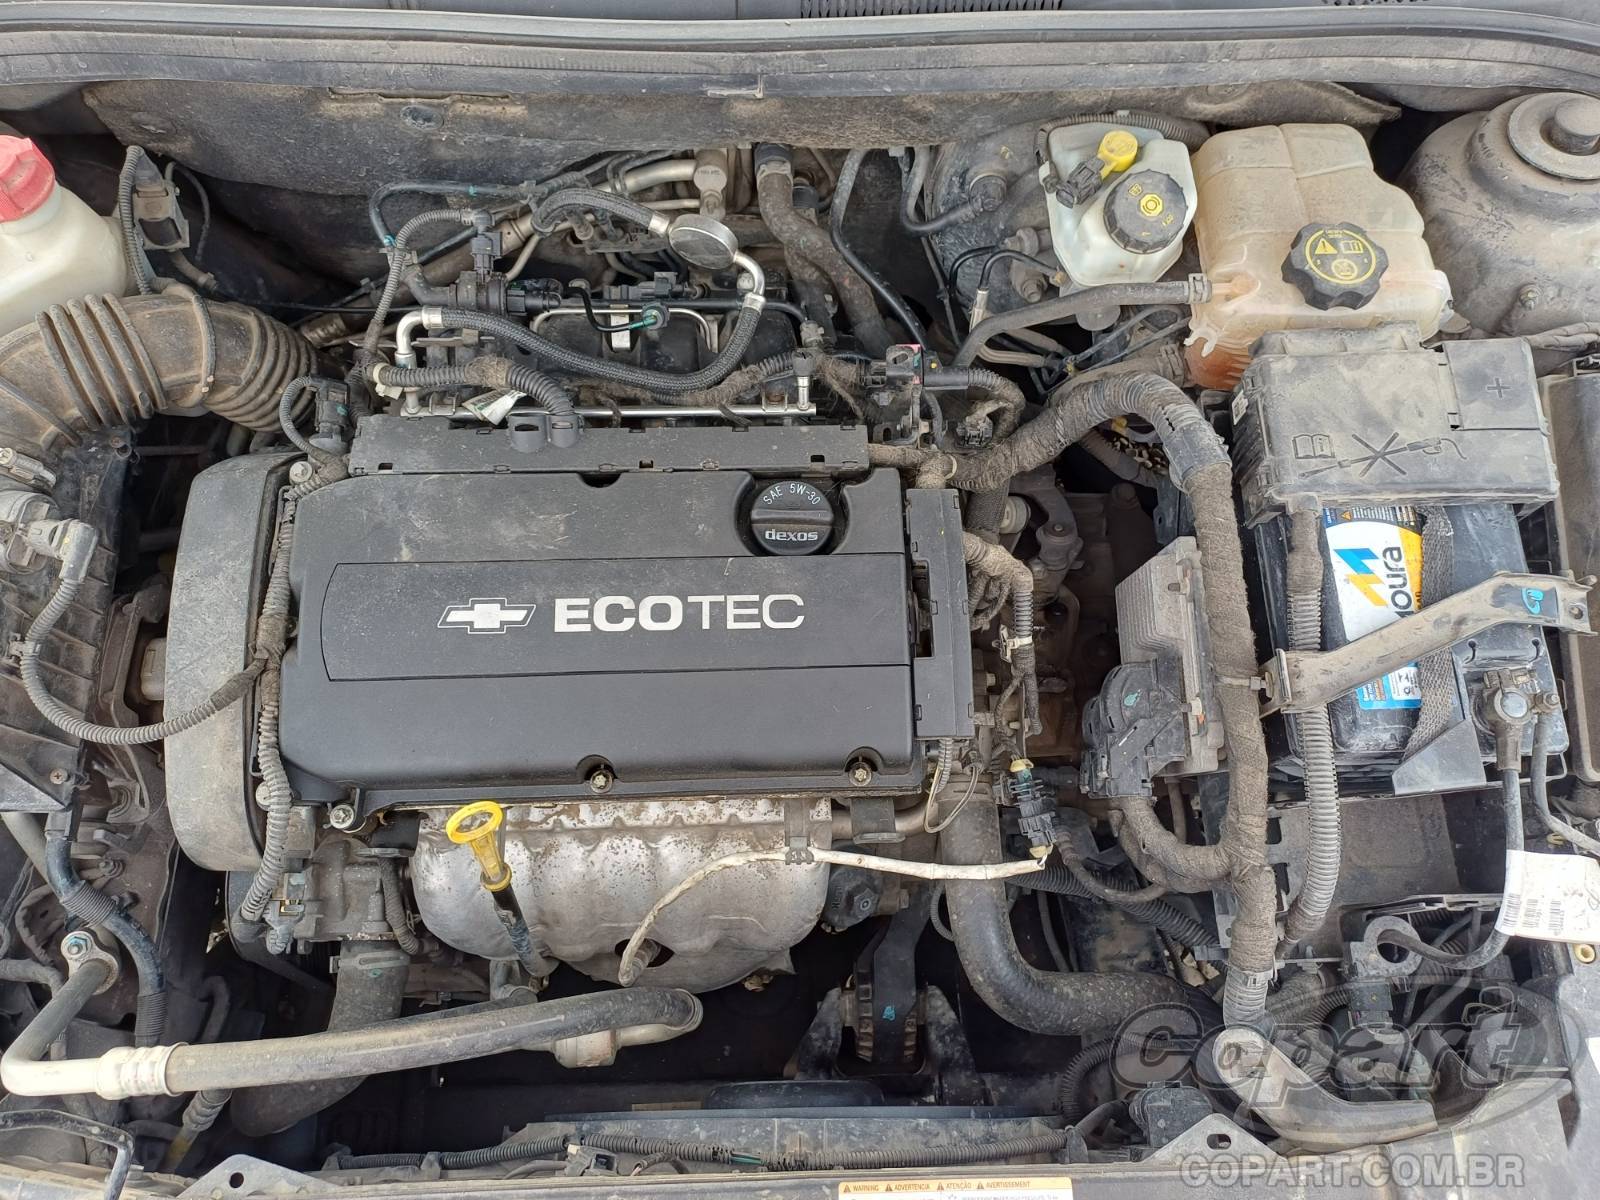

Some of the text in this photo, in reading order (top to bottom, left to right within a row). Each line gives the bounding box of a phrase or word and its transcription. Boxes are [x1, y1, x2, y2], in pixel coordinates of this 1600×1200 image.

[763, 483, 821, 505] SAE 5W-30
[764, 529, 818, 541] dexos
[1382, 547, 1414, 618] oura
[553, 594, 805, 632] ECOTEC
